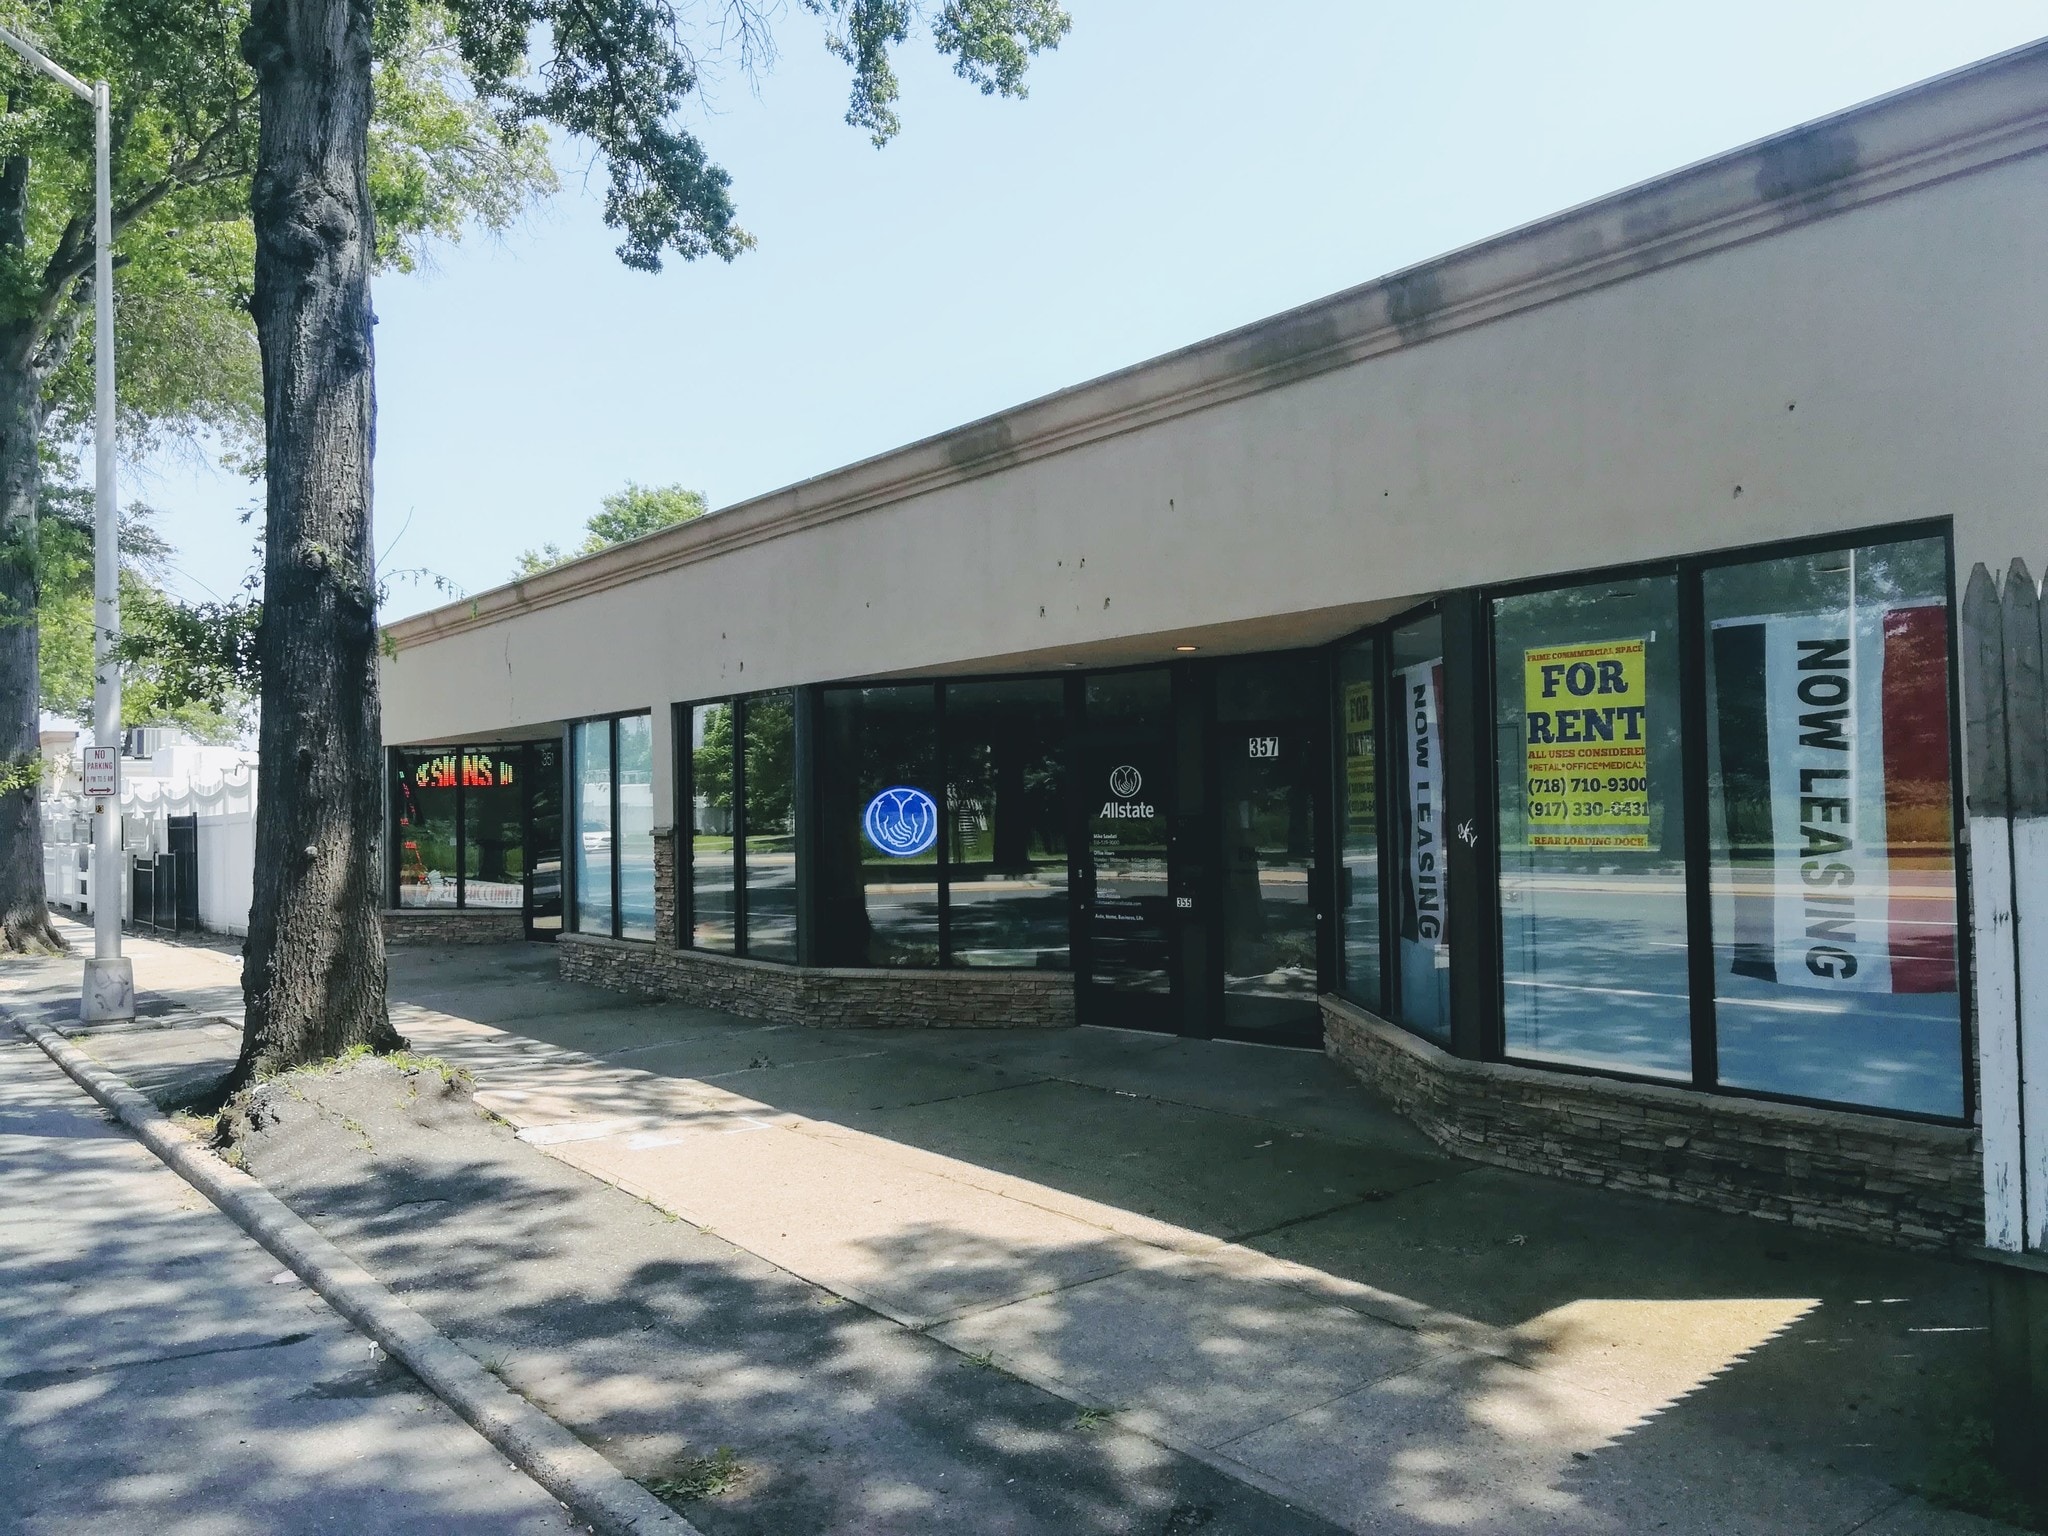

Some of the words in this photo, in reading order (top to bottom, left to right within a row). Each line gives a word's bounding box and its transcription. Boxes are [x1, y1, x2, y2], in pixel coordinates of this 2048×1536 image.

[1527, 653, 1552, 662] PRIME
[1615, 644, 1644, 654] SPACE
[1541, 660, 1629, 698] FOR
[1797, 638, 1851, 751] NOW
[1413, 684, 1429, 768] NOW
[1527, 705, 1645, 744] RENT
[94, 750, 106, 759] NO
[1250, 737, 1278, 757] 357
[1528, 751, 1547, 759] ALL
[1549, 749, 1576, 758] USES
[87, 761, 113, 770] PARKING
[1528, 777, 1567, 796] (718)
[1570, 776, 1647, 793] 710-9300
[1099, 801, 1155, 819] Allstate
[1528, 800, 1568, 820] (917)
[1534, 837, 1561, 846] REAR
[1564, 837, 1611, 846] LOADING
[1416, 781, 1441, 939] LEASING
[1800, 768, 1858, 979] LEASING
